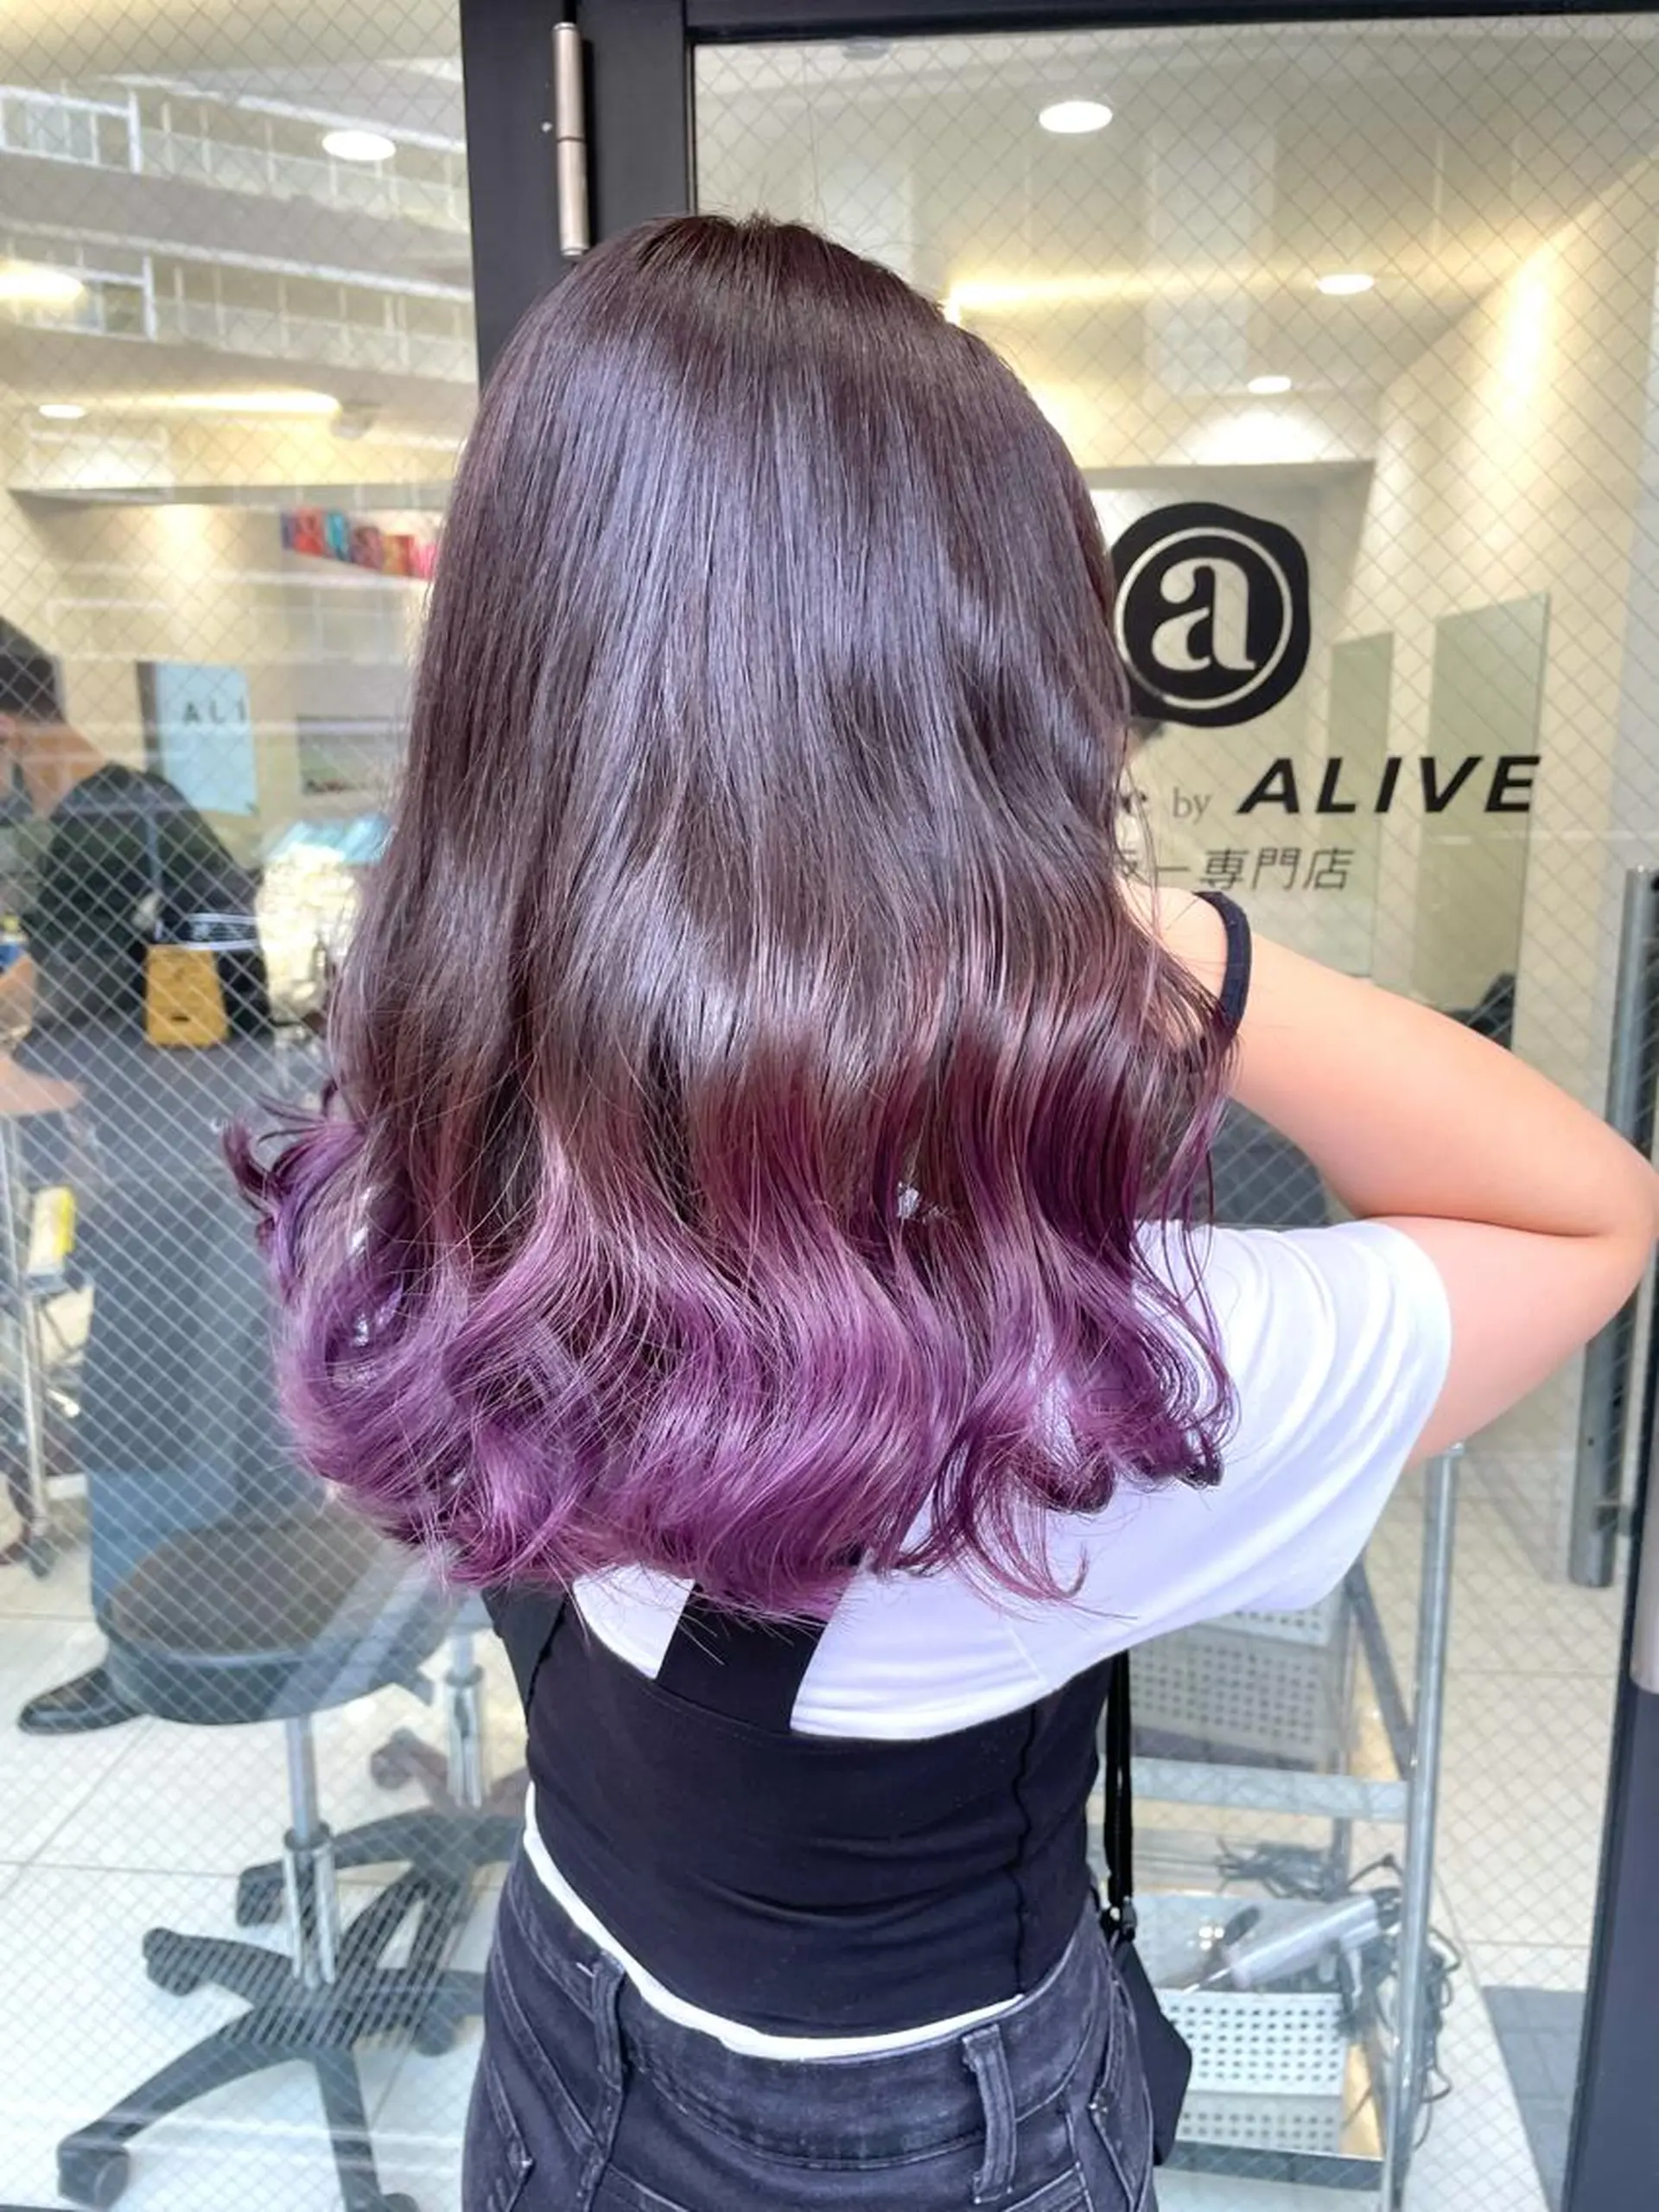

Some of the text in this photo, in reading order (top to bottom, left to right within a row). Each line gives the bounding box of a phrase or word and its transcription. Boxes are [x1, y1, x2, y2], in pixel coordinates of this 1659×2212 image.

[1152, 557, 1255, 671] a
[1173, 787, 1212, 825] by
[1236, 755, 1541, 814] ALIVE
